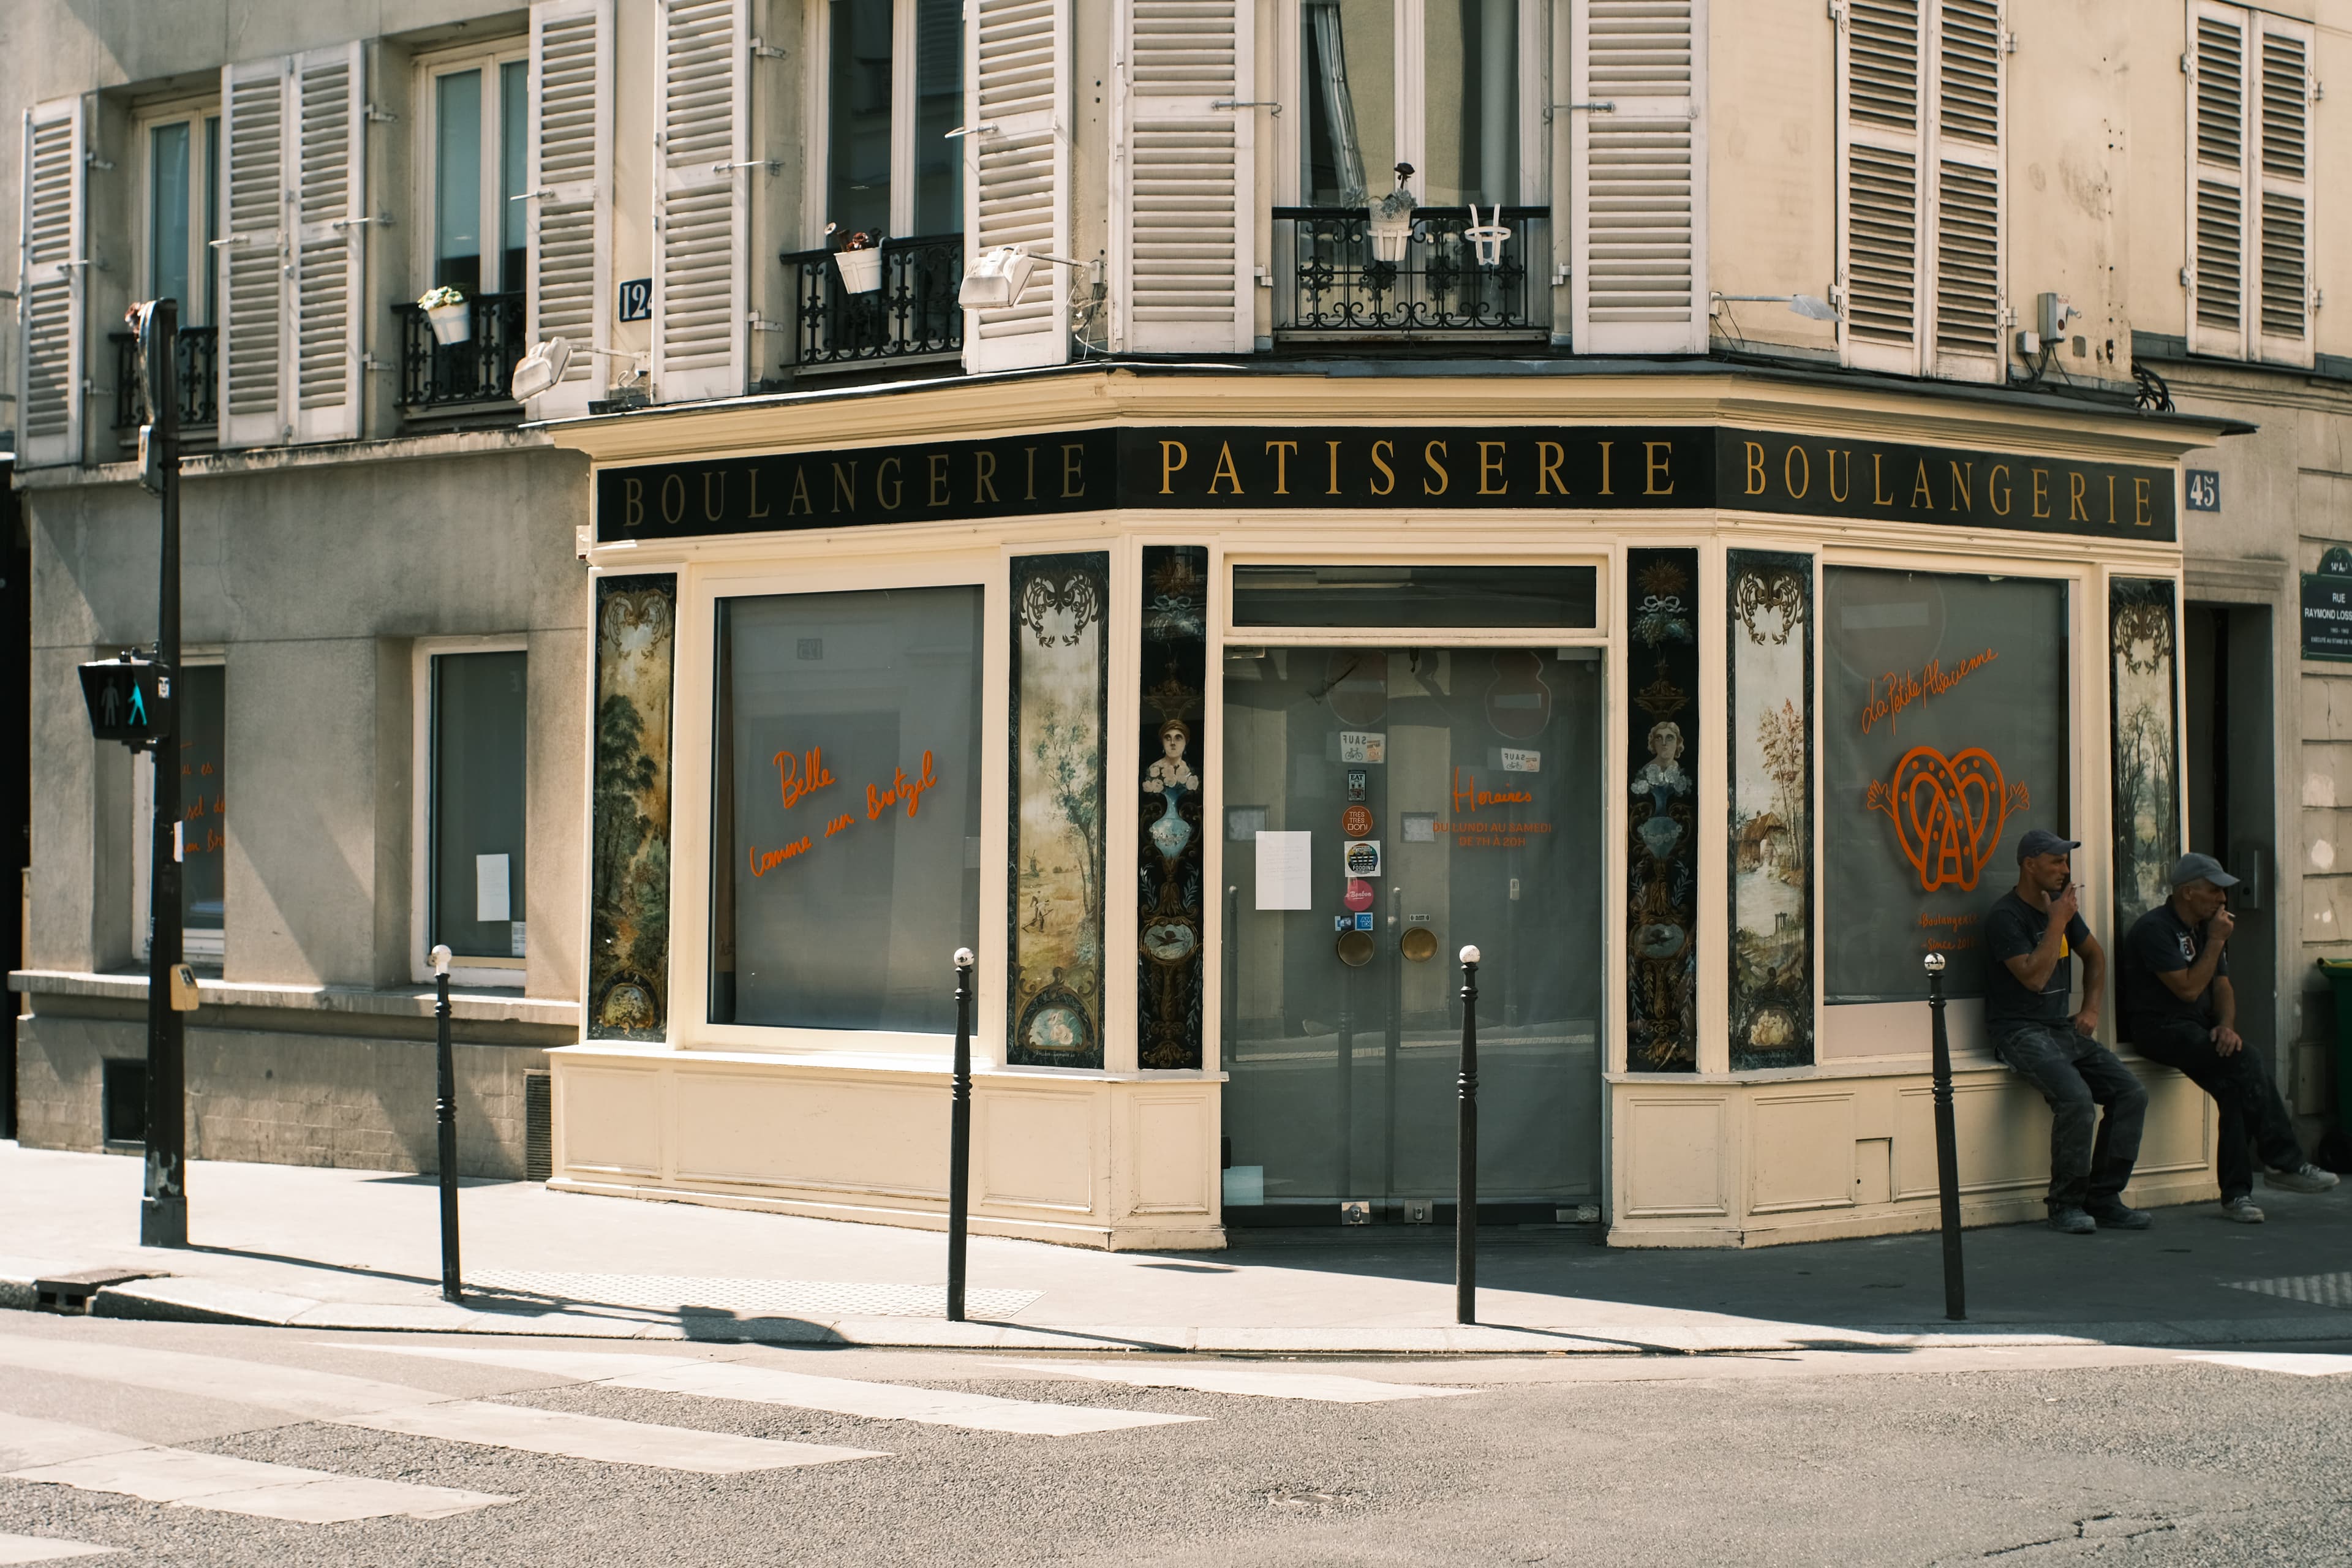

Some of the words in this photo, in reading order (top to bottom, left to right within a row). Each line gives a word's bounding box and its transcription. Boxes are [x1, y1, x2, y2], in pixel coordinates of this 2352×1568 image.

[623, 443, 1087, 527] BOULANGERIE
[1158, 440, 1675, 496] PATISSERIE
[1744, 441, 2153, 527] BOULANGERIE
[2190, 475, 2215, 507] 45
[2304, 608, 2335, 619] RAYMOND
[2332, 592, 2346, 604] RUE
[1861, 677, 1888, 735] La
[1882, 668, 1921, 736] Petite
[1922, 647, 1999, 709] Alsacienne
[772, 745, 836, 809] Belle
[1452, 766, 1532, 813] Horaires
[750, 835, 813, 877] Comme
[824, 813, 855, 838] un
[866, 750, 937, 821] Bretzel
[1433, 823, 1449, 832] DU
[1452, 823, 1488, 833] LUNDI
[1490, 823, 1506, 833] AU
[1509, 823, 1551, 834] SAMEDI
[1458, 836, 1473, 846] DE
[1476, 836, 1490, 846] 7H
[1503, 837, 1526, 847] 20H
